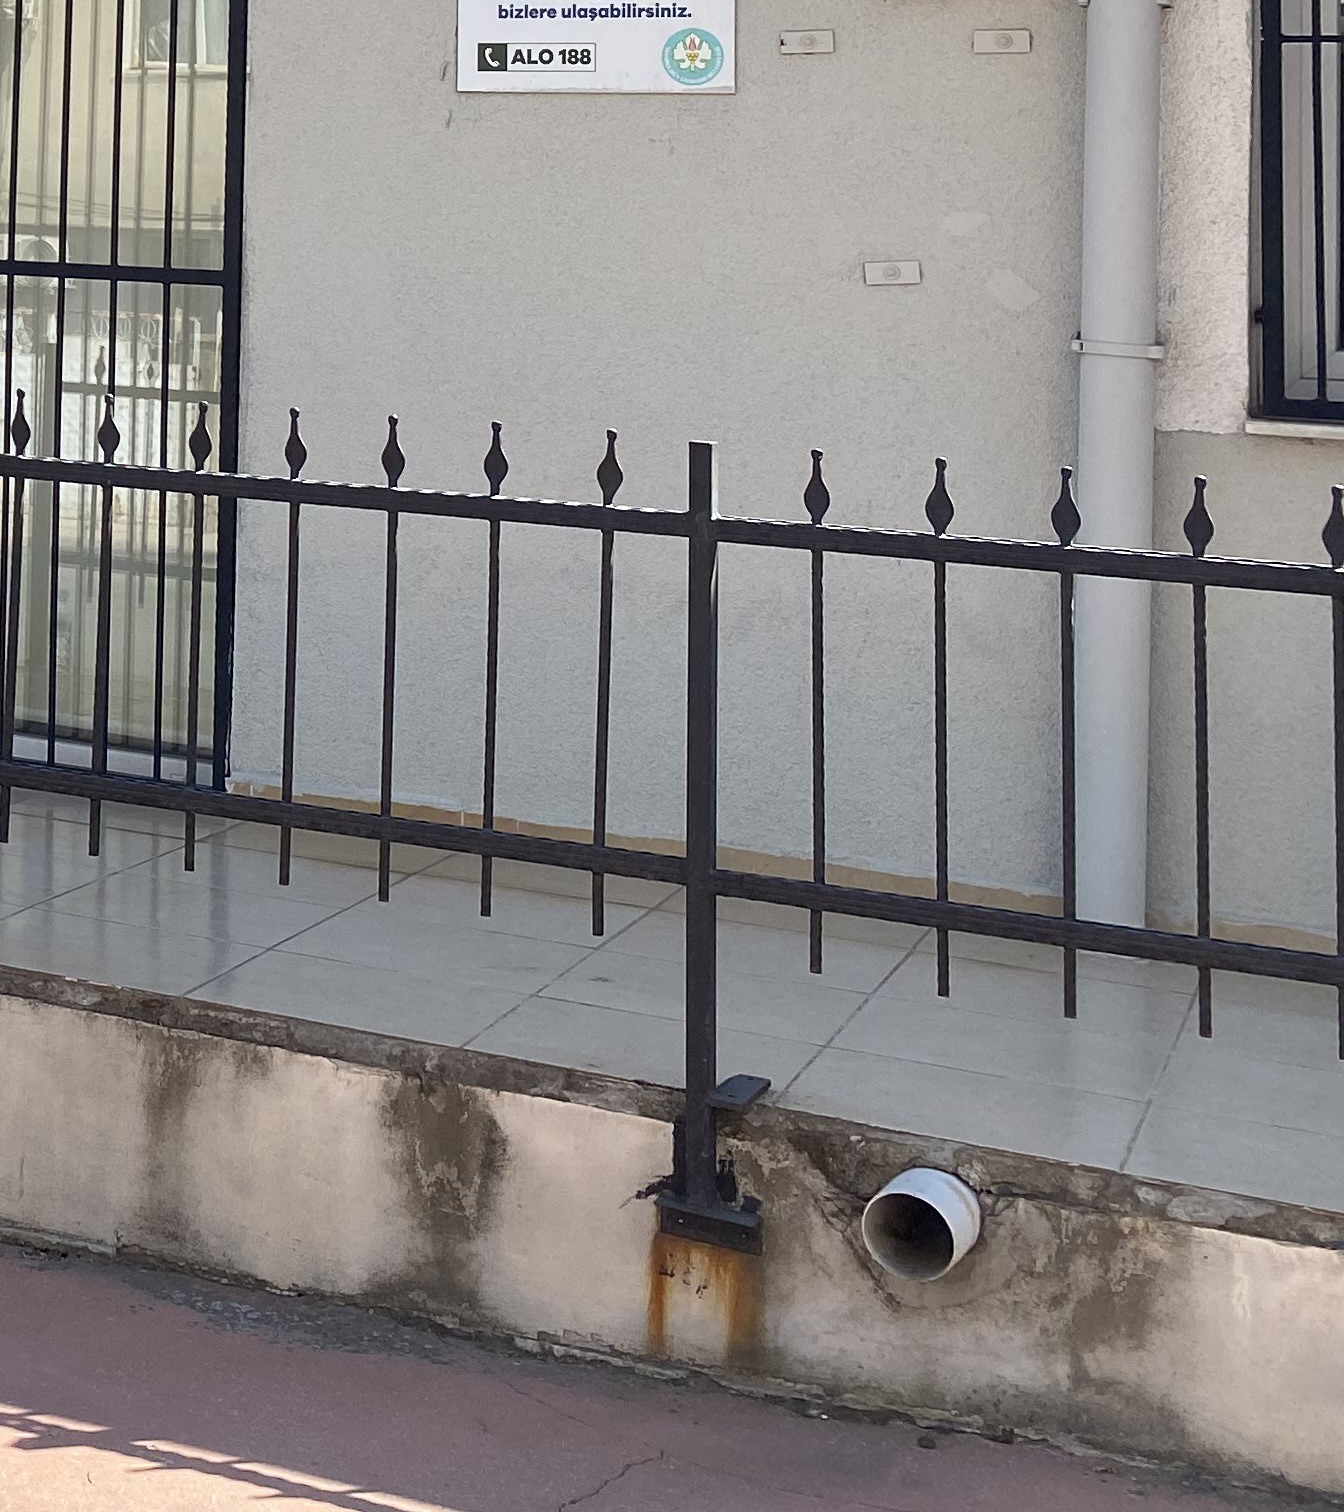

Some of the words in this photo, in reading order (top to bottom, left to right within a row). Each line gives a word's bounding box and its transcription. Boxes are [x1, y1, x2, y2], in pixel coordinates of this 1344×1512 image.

[498, 5, 557, 20] bizlere
[562, 3, 693, 21] ulaşabilirsiniz.
[511, 49, 553, 65] ALO
[558, 48, 591, 64] 188
